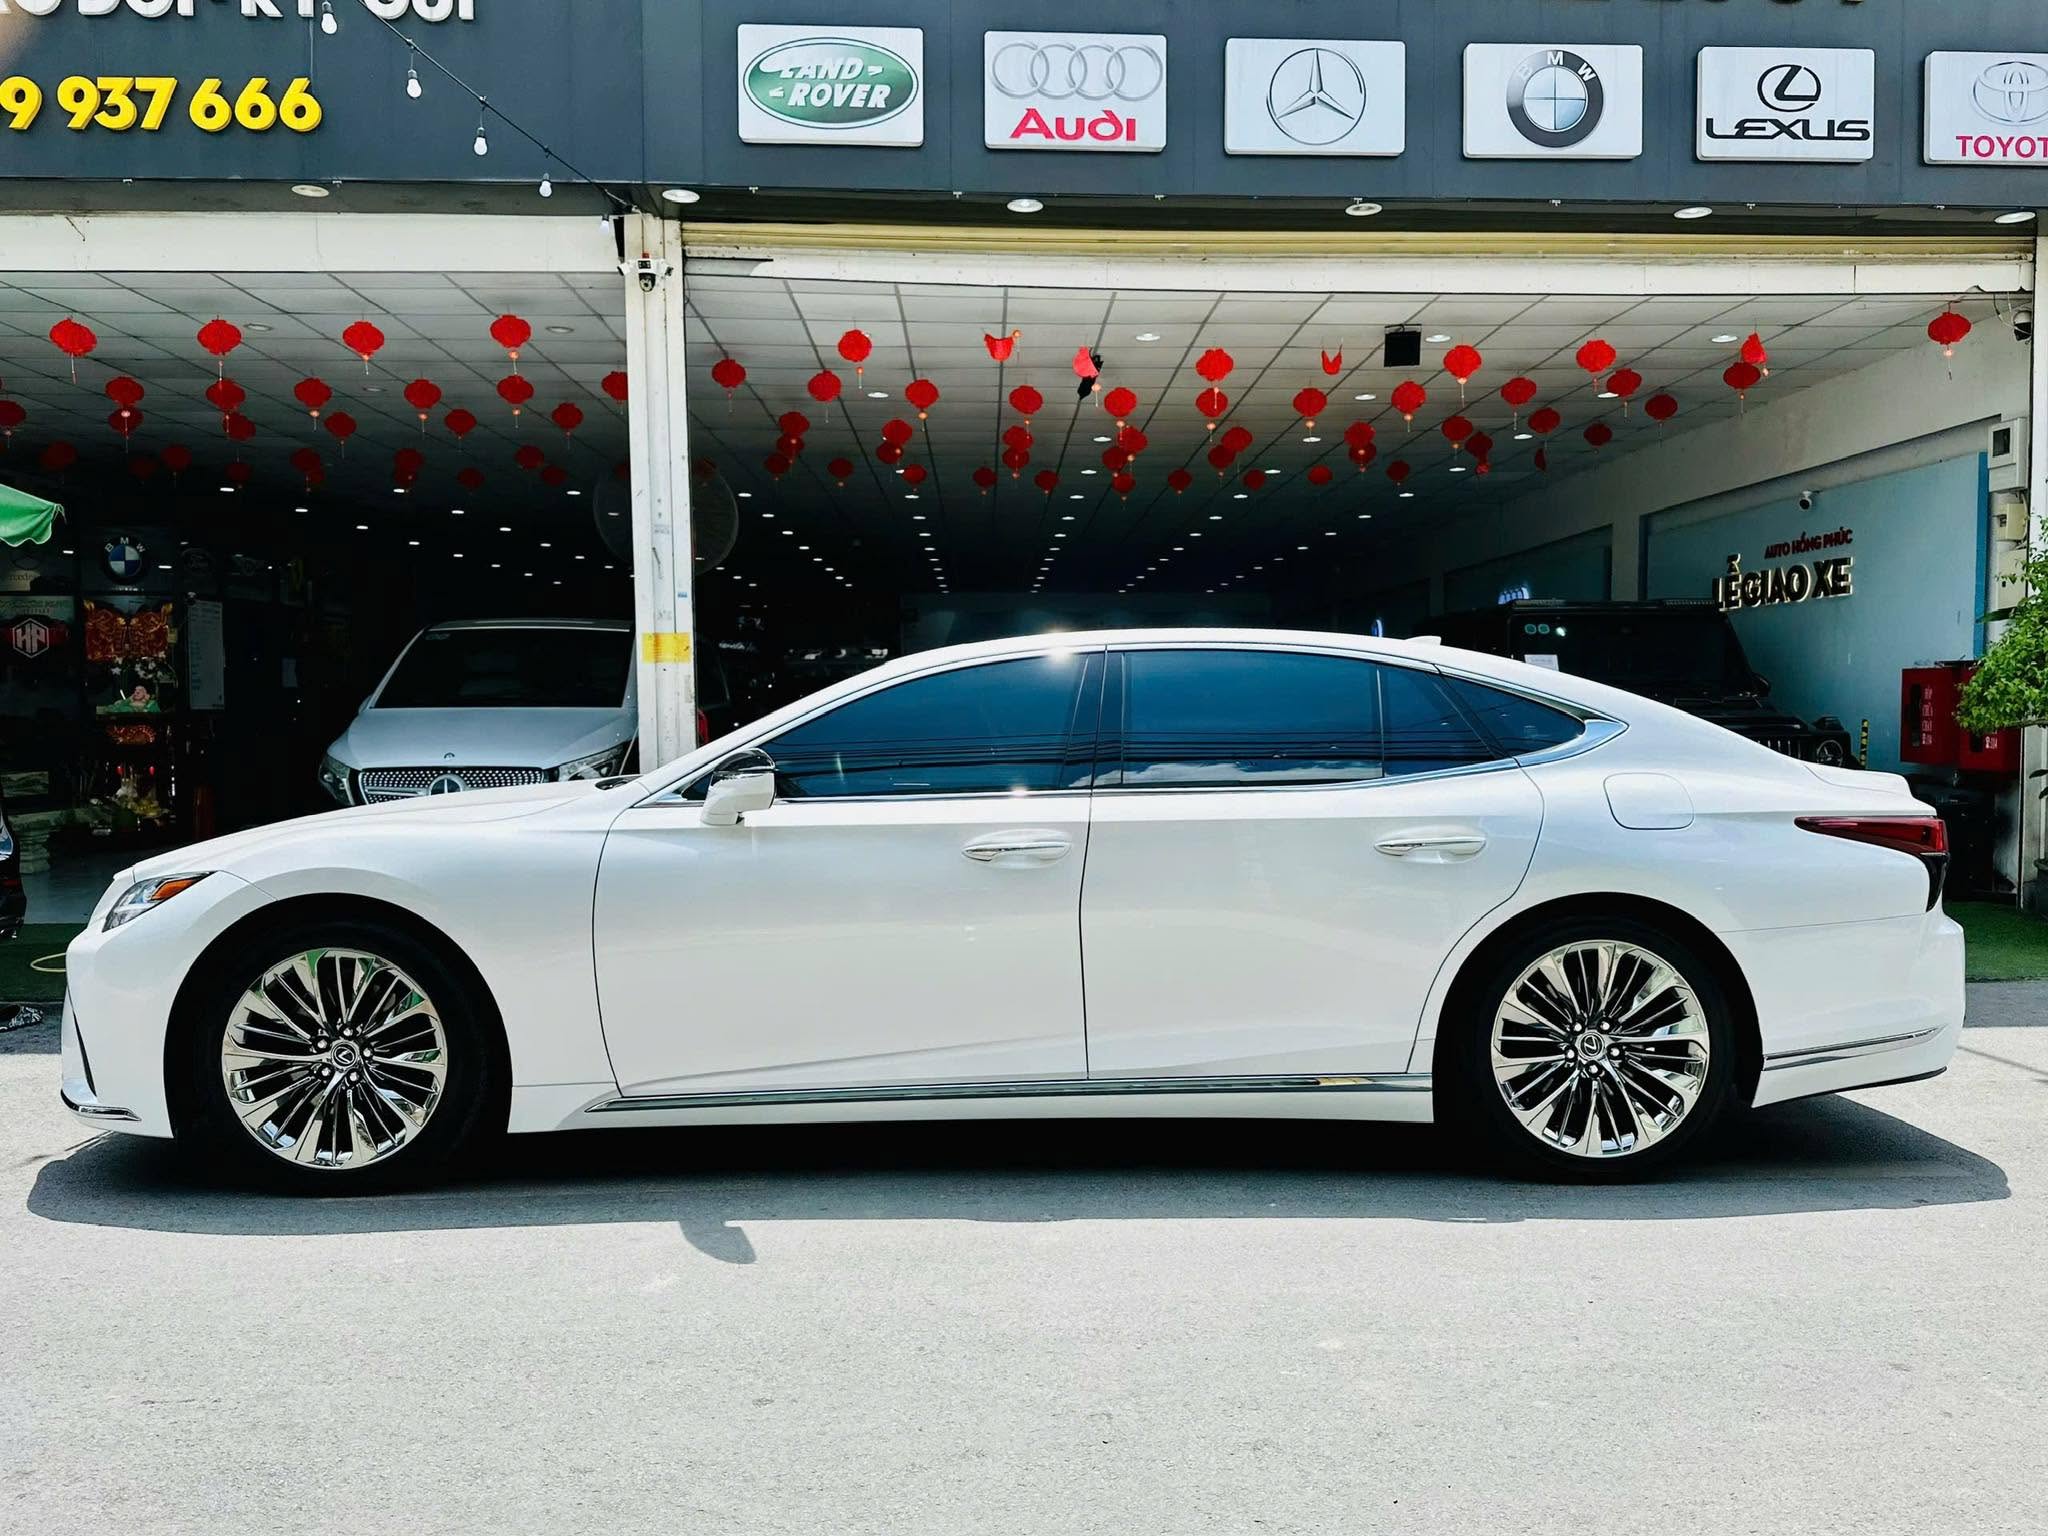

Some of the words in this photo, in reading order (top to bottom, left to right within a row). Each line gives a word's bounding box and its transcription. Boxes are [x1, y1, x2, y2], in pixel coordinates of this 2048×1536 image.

[776, 57, 864, 80] LAND
[1518, 50, 1597, 82] BMW
[57, 75, 177, 131] 937
[189, 77, 323, 132] 666
[787, 83, 891, 108] ROVER
[1009, 108, 1137, 142] Audi
[1705, 117, 1870, 141] LEXUS
[104, 536, 146, 553] BMW
[1764, 541, 1790, 559] AUTO
[1742, 564, 1811, 608] GIAO
[1811, 556, 1854, 599] XE
